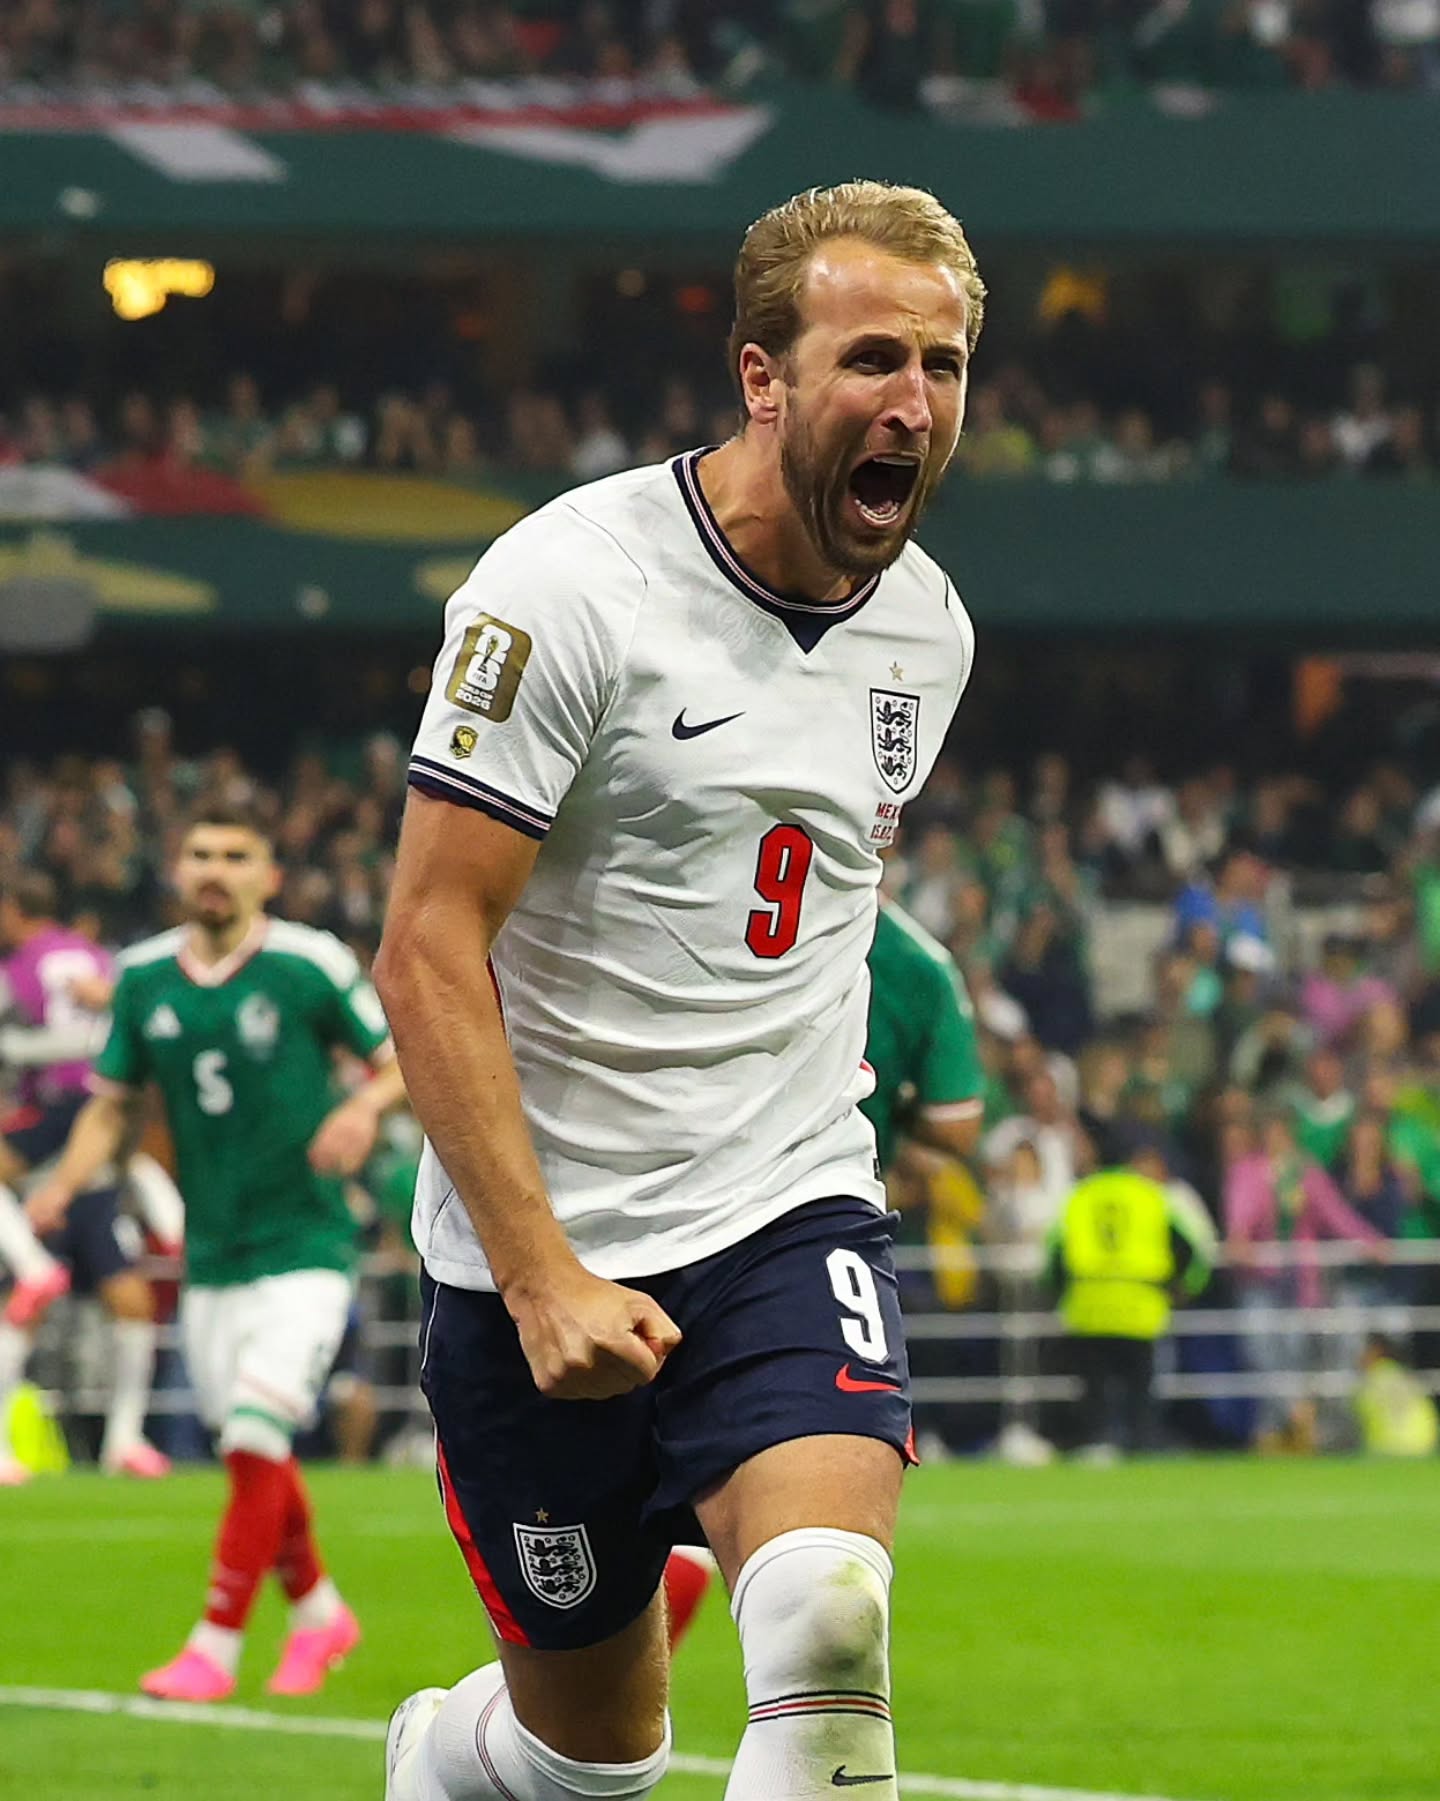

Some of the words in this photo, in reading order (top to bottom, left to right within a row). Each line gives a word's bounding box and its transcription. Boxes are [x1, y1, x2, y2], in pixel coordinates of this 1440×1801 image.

[455, 688, 492, 711] 2026
[744, 823, 813, 959] 9
[192, 1049, 234, 1117] 5
[825, 1247, 890, 1365] 9
